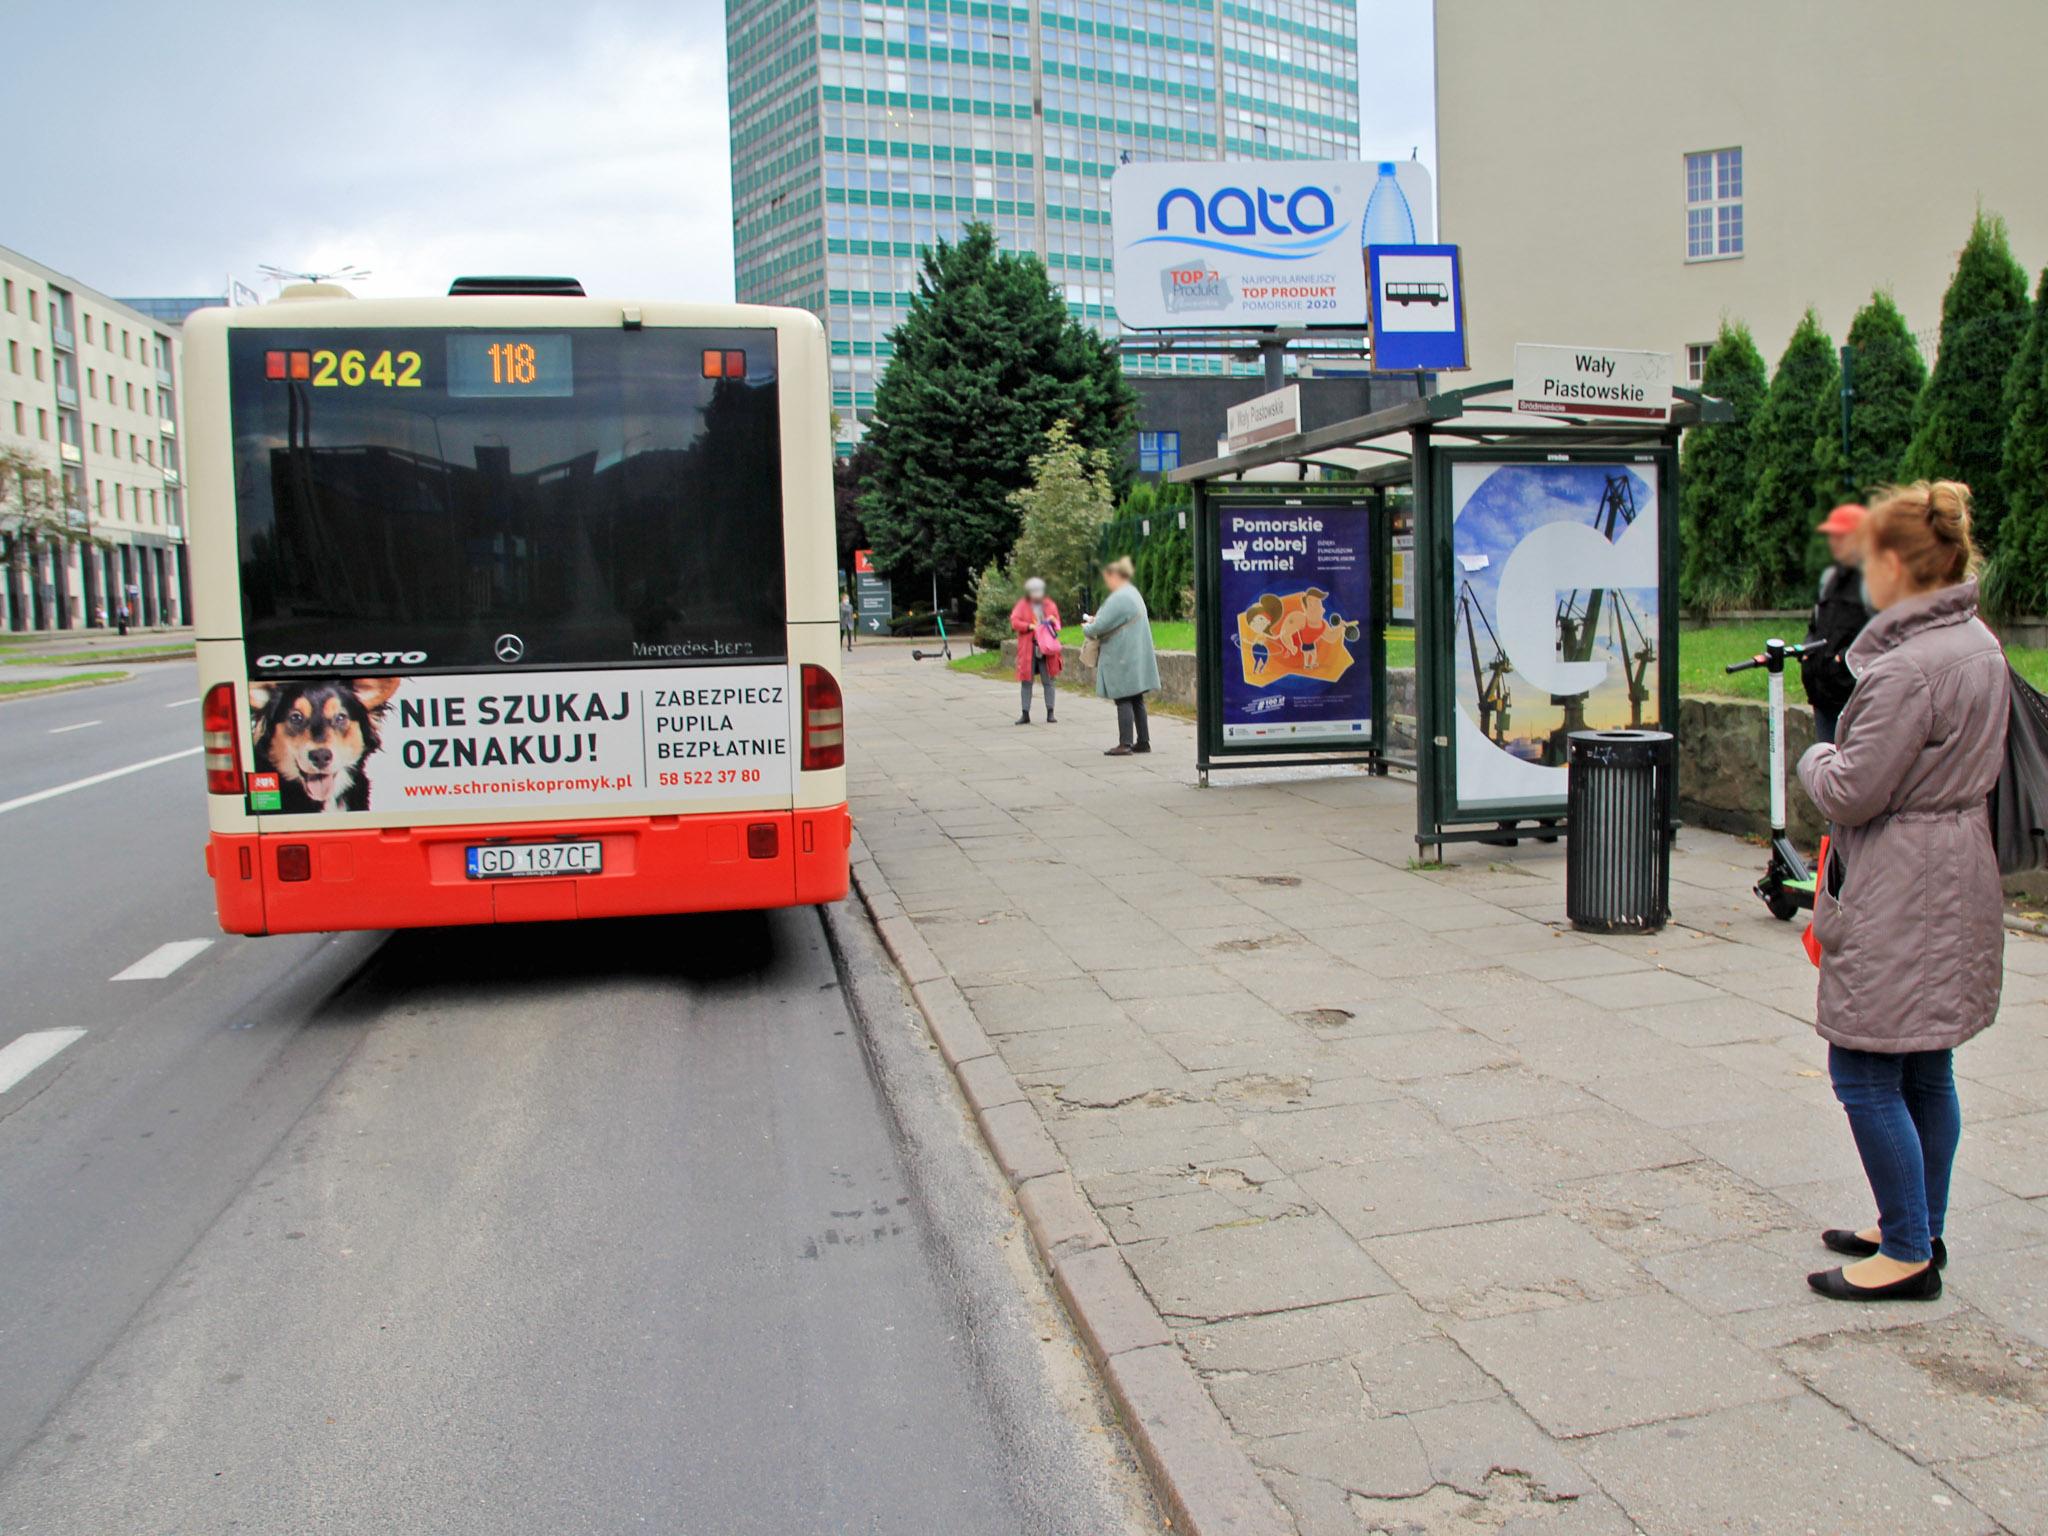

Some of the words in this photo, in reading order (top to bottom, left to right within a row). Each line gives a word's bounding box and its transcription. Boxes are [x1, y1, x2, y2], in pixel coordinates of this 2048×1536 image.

[1157, 185, 1335, 236] nata
[1170, 270, 1204, 286] TOP
[1241, 273, 1337, 286] NAJPOPULARNIEJSZY
[1173, 283, 1219, 298] Produkt
[1242, 287, 1268, 299] TOP
[1271, 286, 1337, 298] PRODUKT
[1242, 301, 1303, 311] POMORSKIE
[1306, 299, 1337, 310] 2020
[311, 349, 423, 389] 2642
[486, 342, 537, 385] 118
[1574, 353, 1616, 378] Wały
[1543, 378, 1645, 402] Piastowskie
[1232, 516, 1324, 533] Pomorskie
[1232, 540, 1248, 552] w
[1252, 535, 1307, 555] dobrej
[256, 651, 428, 668] CONECTO
[655, 687, 783, 707] ZABEZPIECZ
[400, 697, 466, 728] NIE
[477, 691, 630, 726] SZUKAJ
[657, 714, 734, 733] PUPILA
[402, 732, 598, 769] OZNAKUJ!
[658, 738, 786, 759] BEZPŁATNIE
[403, 774, 632, 798] www.schroniskopromyk.pl
[659, 772, 679, 786] 58
[683, 771, 713, 785] 522
[717, 769, 737, 784] 37
[741, 768, 761, 783] 80
[482, 849, 516, 872] GD
[526, 845, 595, 870] 187CF
